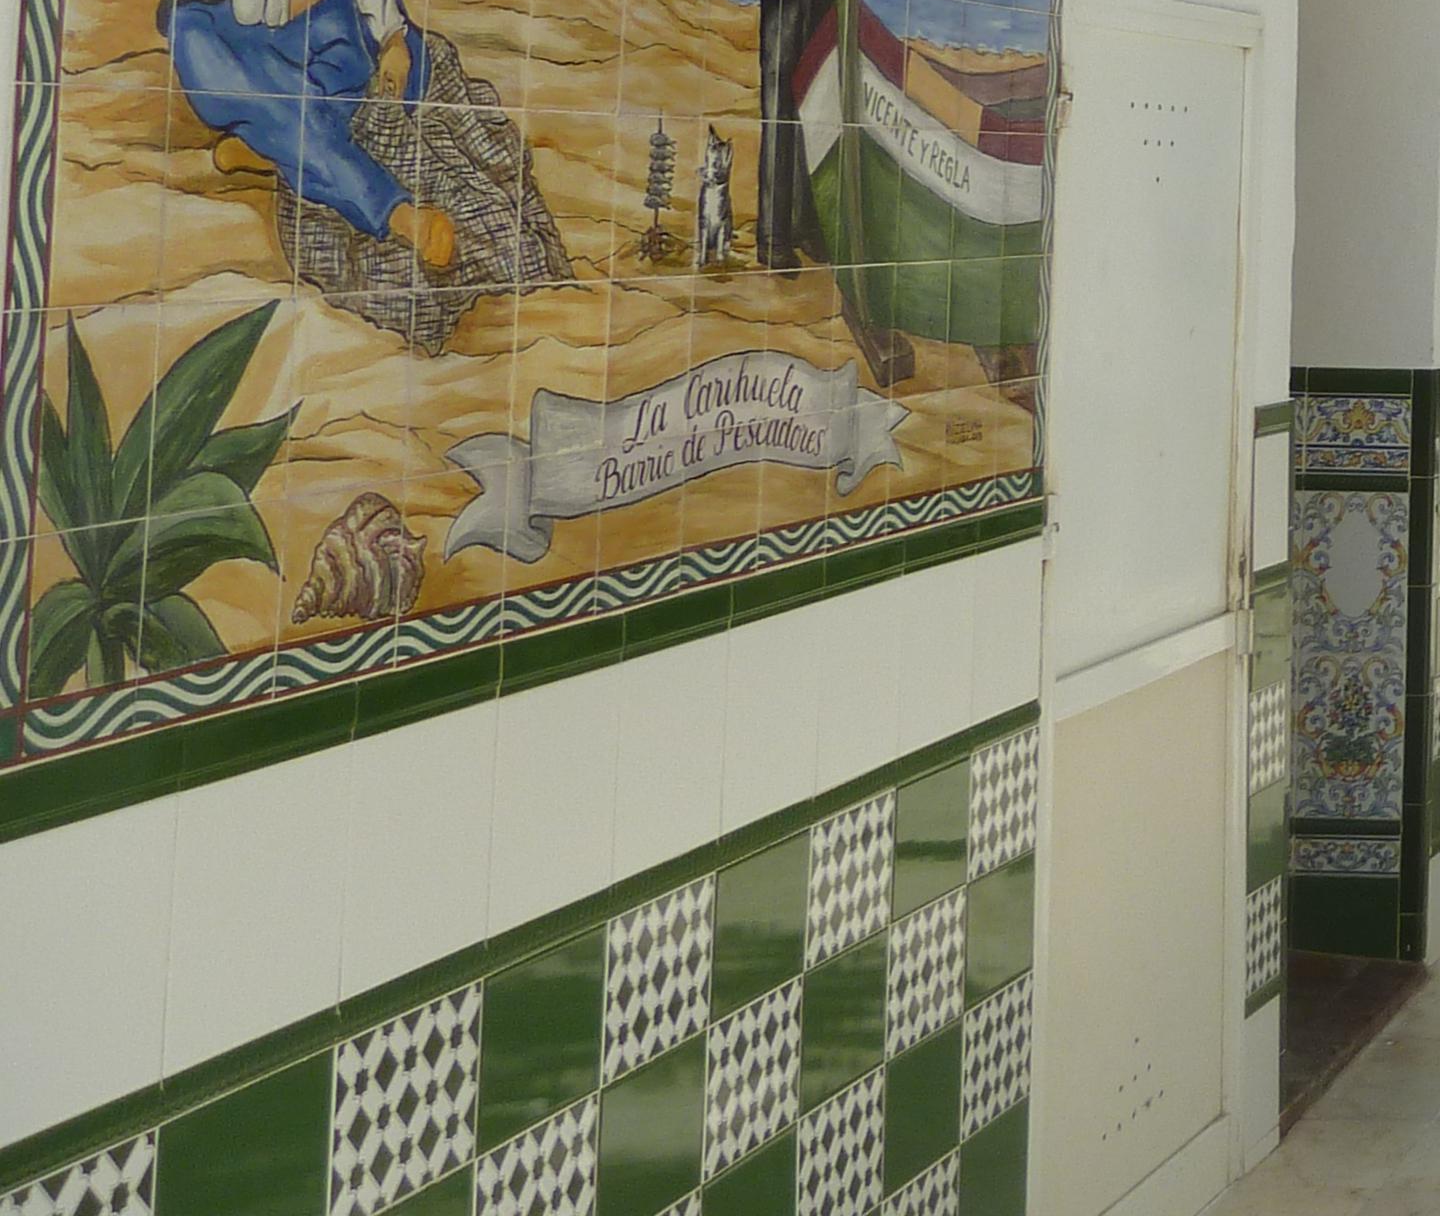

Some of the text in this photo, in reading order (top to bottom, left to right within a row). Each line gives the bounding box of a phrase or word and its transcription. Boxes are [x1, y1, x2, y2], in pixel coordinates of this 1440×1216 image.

[864, 82, 918, 157] VICENTE
[931, 139, 970, 192] REGLA
[622, 358, 803, 453] La Carihuela
[595, 409, 827, 502] Barrio de Pescadores
